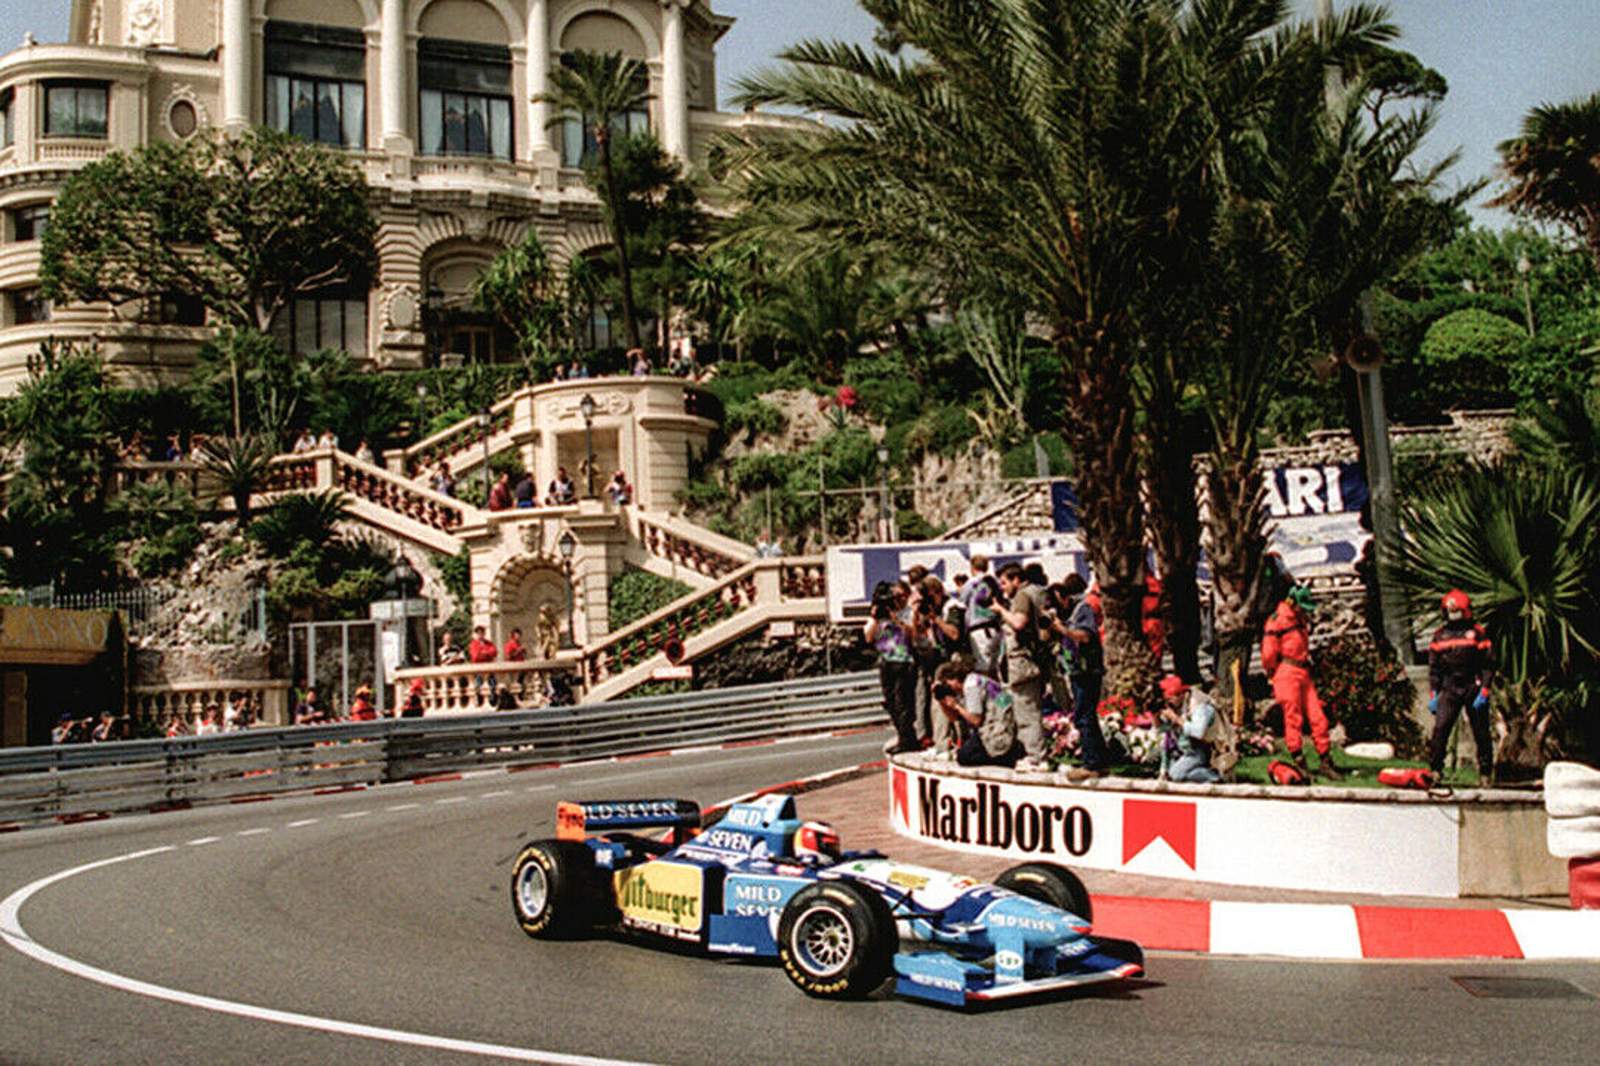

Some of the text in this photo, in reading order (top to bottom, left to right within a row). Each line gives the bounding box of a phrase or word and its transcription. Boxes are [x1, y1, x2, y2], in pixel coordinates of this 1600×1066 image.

[1260, 465, 1344, 516] ARI
[617, 802, 677, 818] SEVEN
[727, 809, 761, 826] MILD
[917, 776, 1093, 857] Marlboro
[708, 830, 752, 850] SEVEN
[622, 873, 698, 922] itburger
[736, 885, 781, 901] MILD
[736, 903, 784, 917] SEVE
